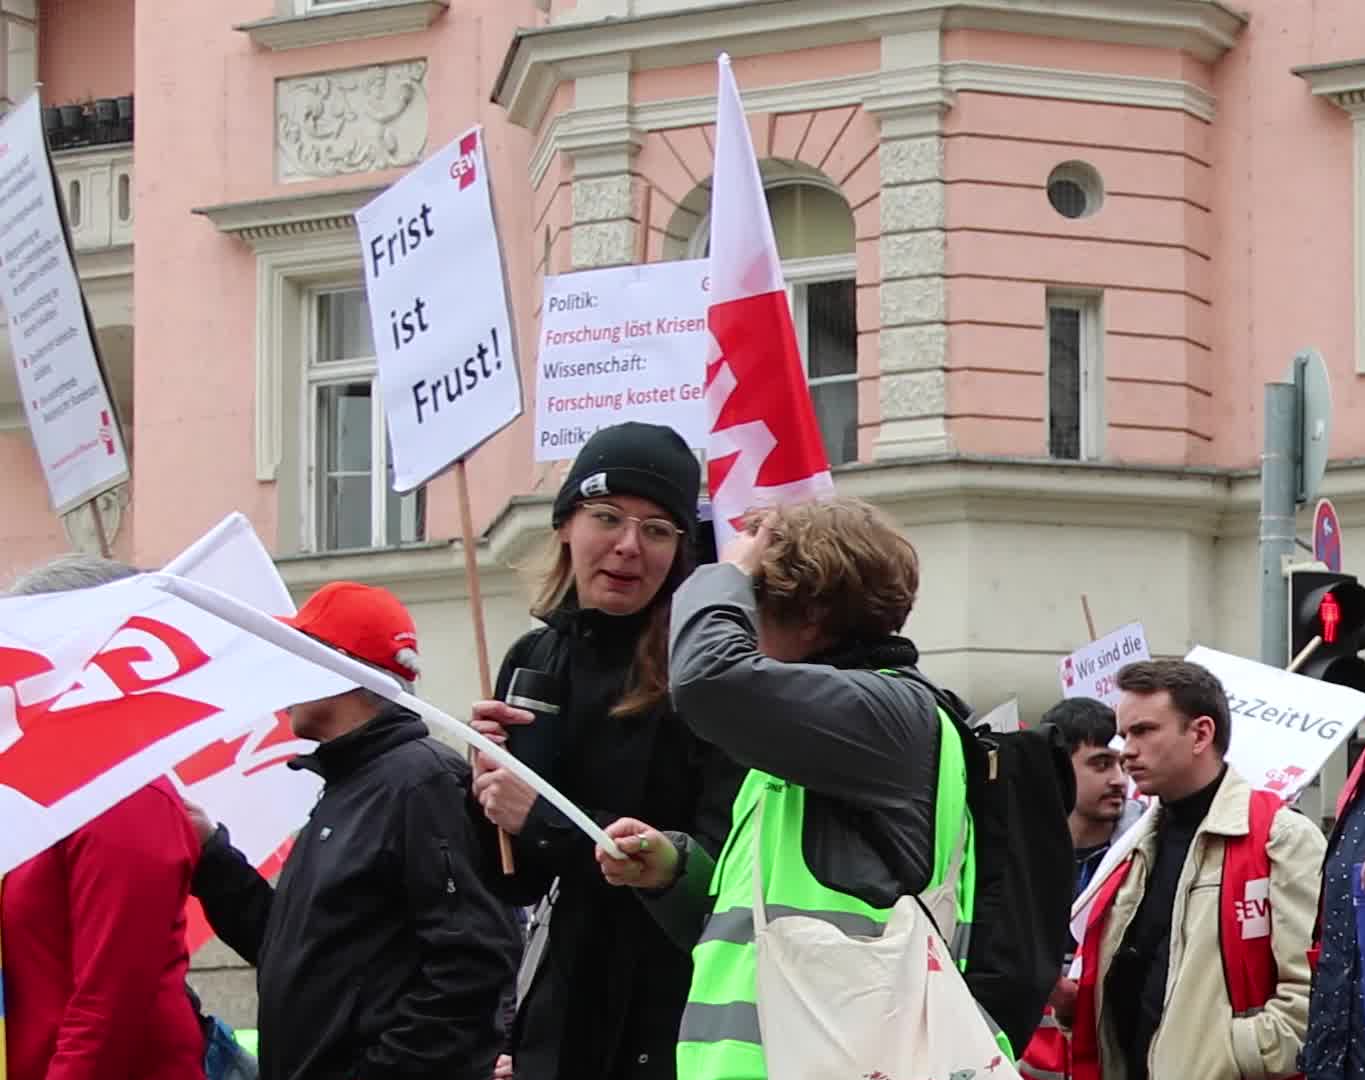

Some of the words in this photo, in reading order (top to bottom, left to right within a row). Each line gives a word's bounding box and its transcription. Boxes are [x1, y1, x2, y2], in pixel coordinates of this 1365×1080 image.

[370, 202, 434, 278] Frist
[548, 292, 600, 313] Politik:
[390, 296, 430, 350] ist
[546, 324, 622, 346] Forschung
[624, 319, 653, 339] löst
[656, 315, 706, 336] Krisen
[411, 327, 503, 424] Frust!
[543, 354, 648, 380] Wissenschaft:
[547, 392, 623, 413] Forschung
[626, 384, 676, 406] kostet
[1075, 657, 1095, 681] Wir
[1096, 641, 1121, 669] sind
[1121, 635, 1142, 657] die
